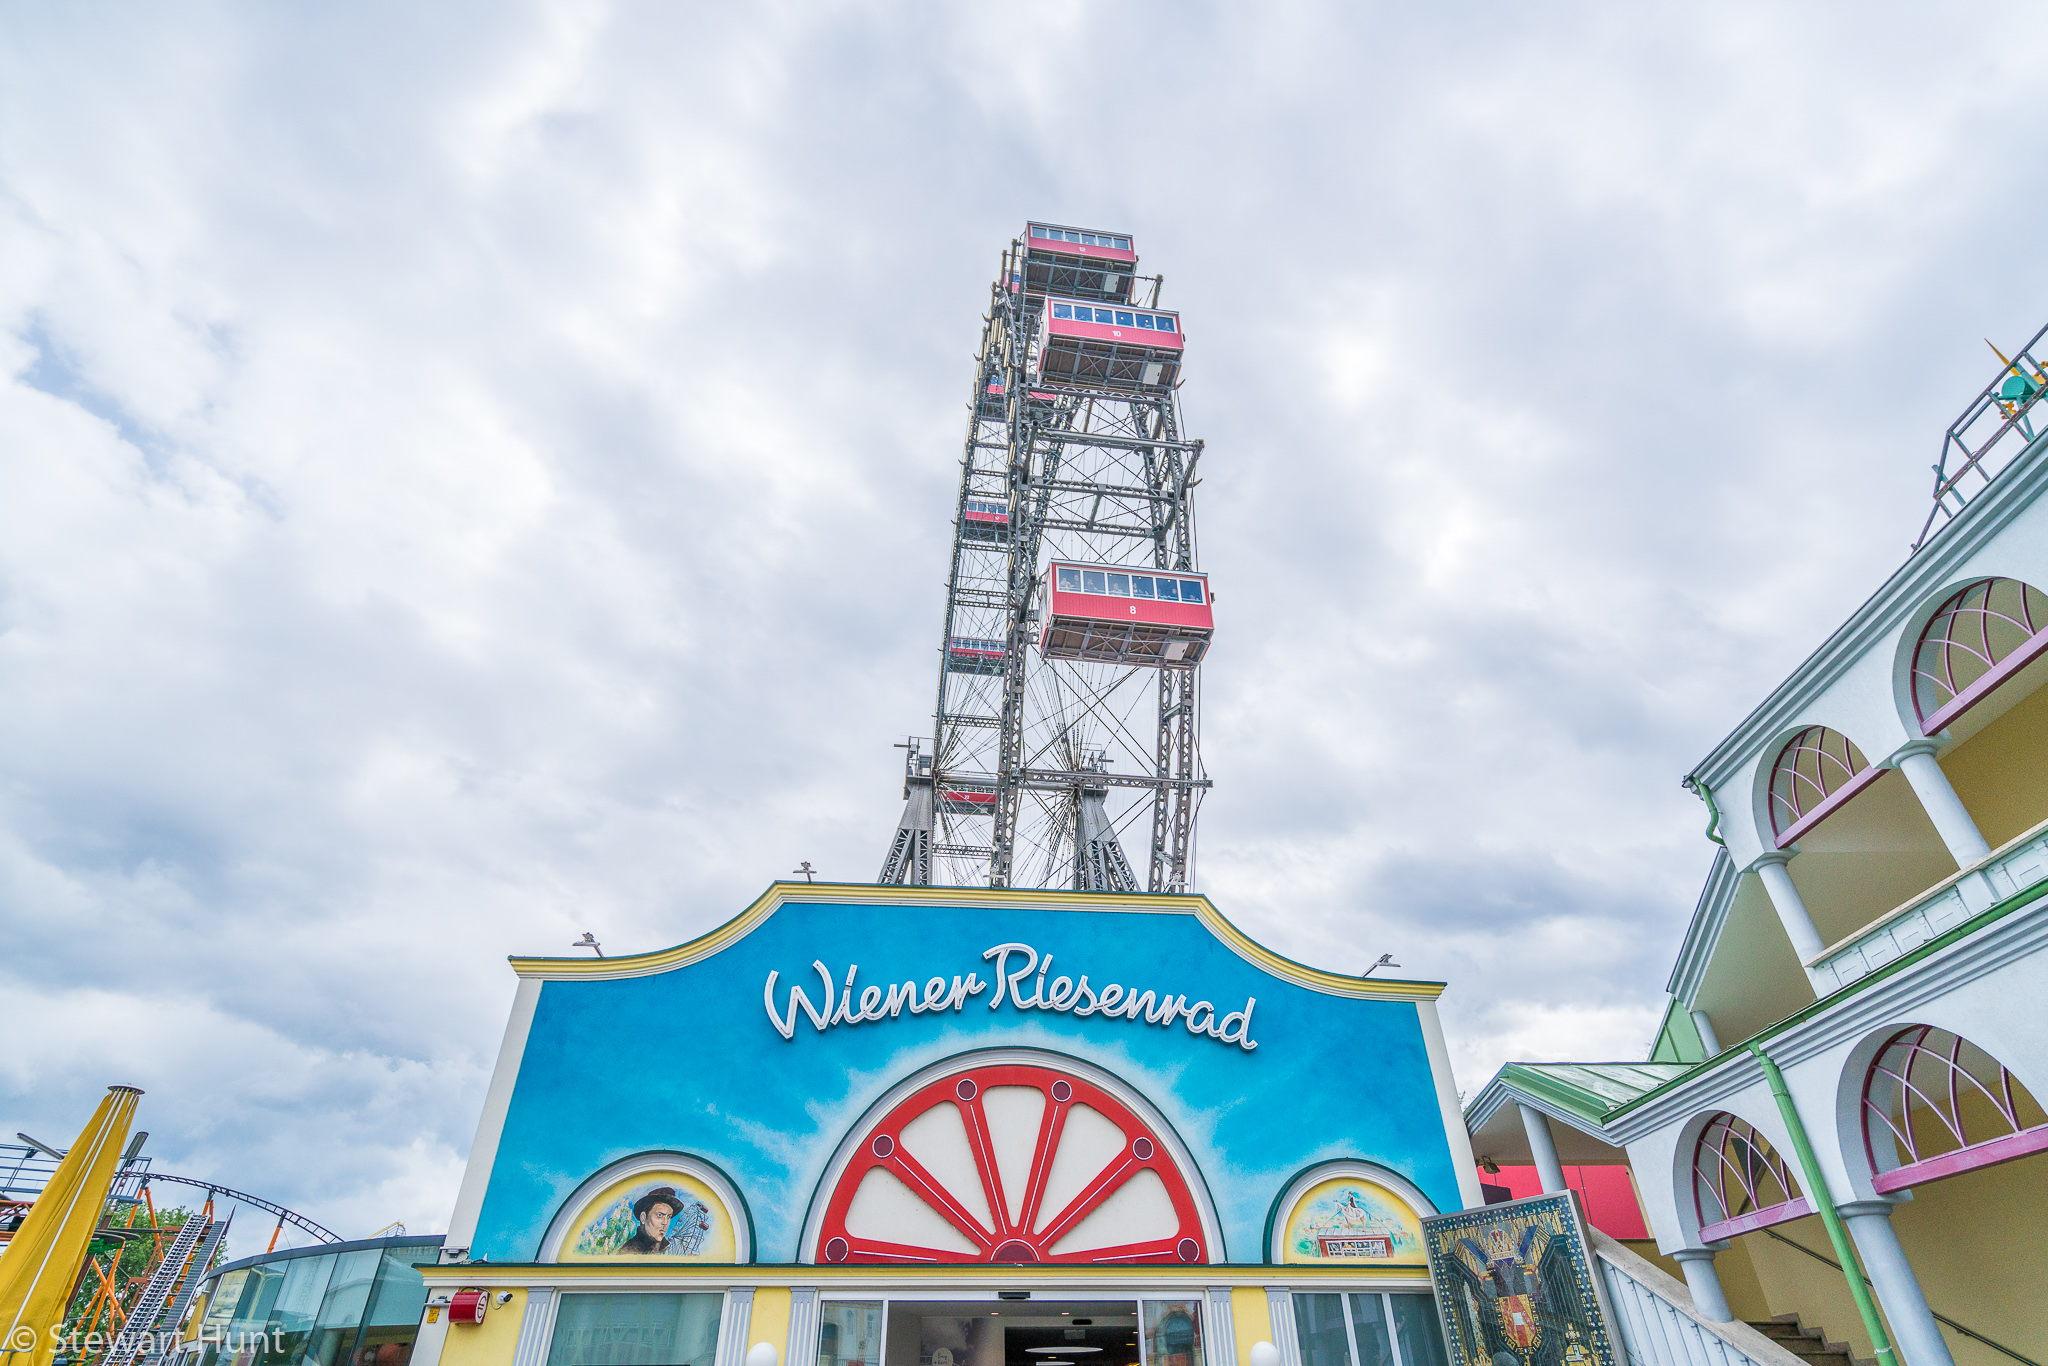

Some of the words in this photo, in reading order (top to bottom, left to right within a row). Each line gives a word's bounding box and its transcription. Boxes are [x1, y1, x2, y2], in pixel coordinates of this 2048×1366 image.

[1112, 330, 1122, 338] 10
[1129, 606, 1137, 615] 8
[764, 959, 987, 1041] Wiener
[982, 942, 1259, 1053] Riesenrad
